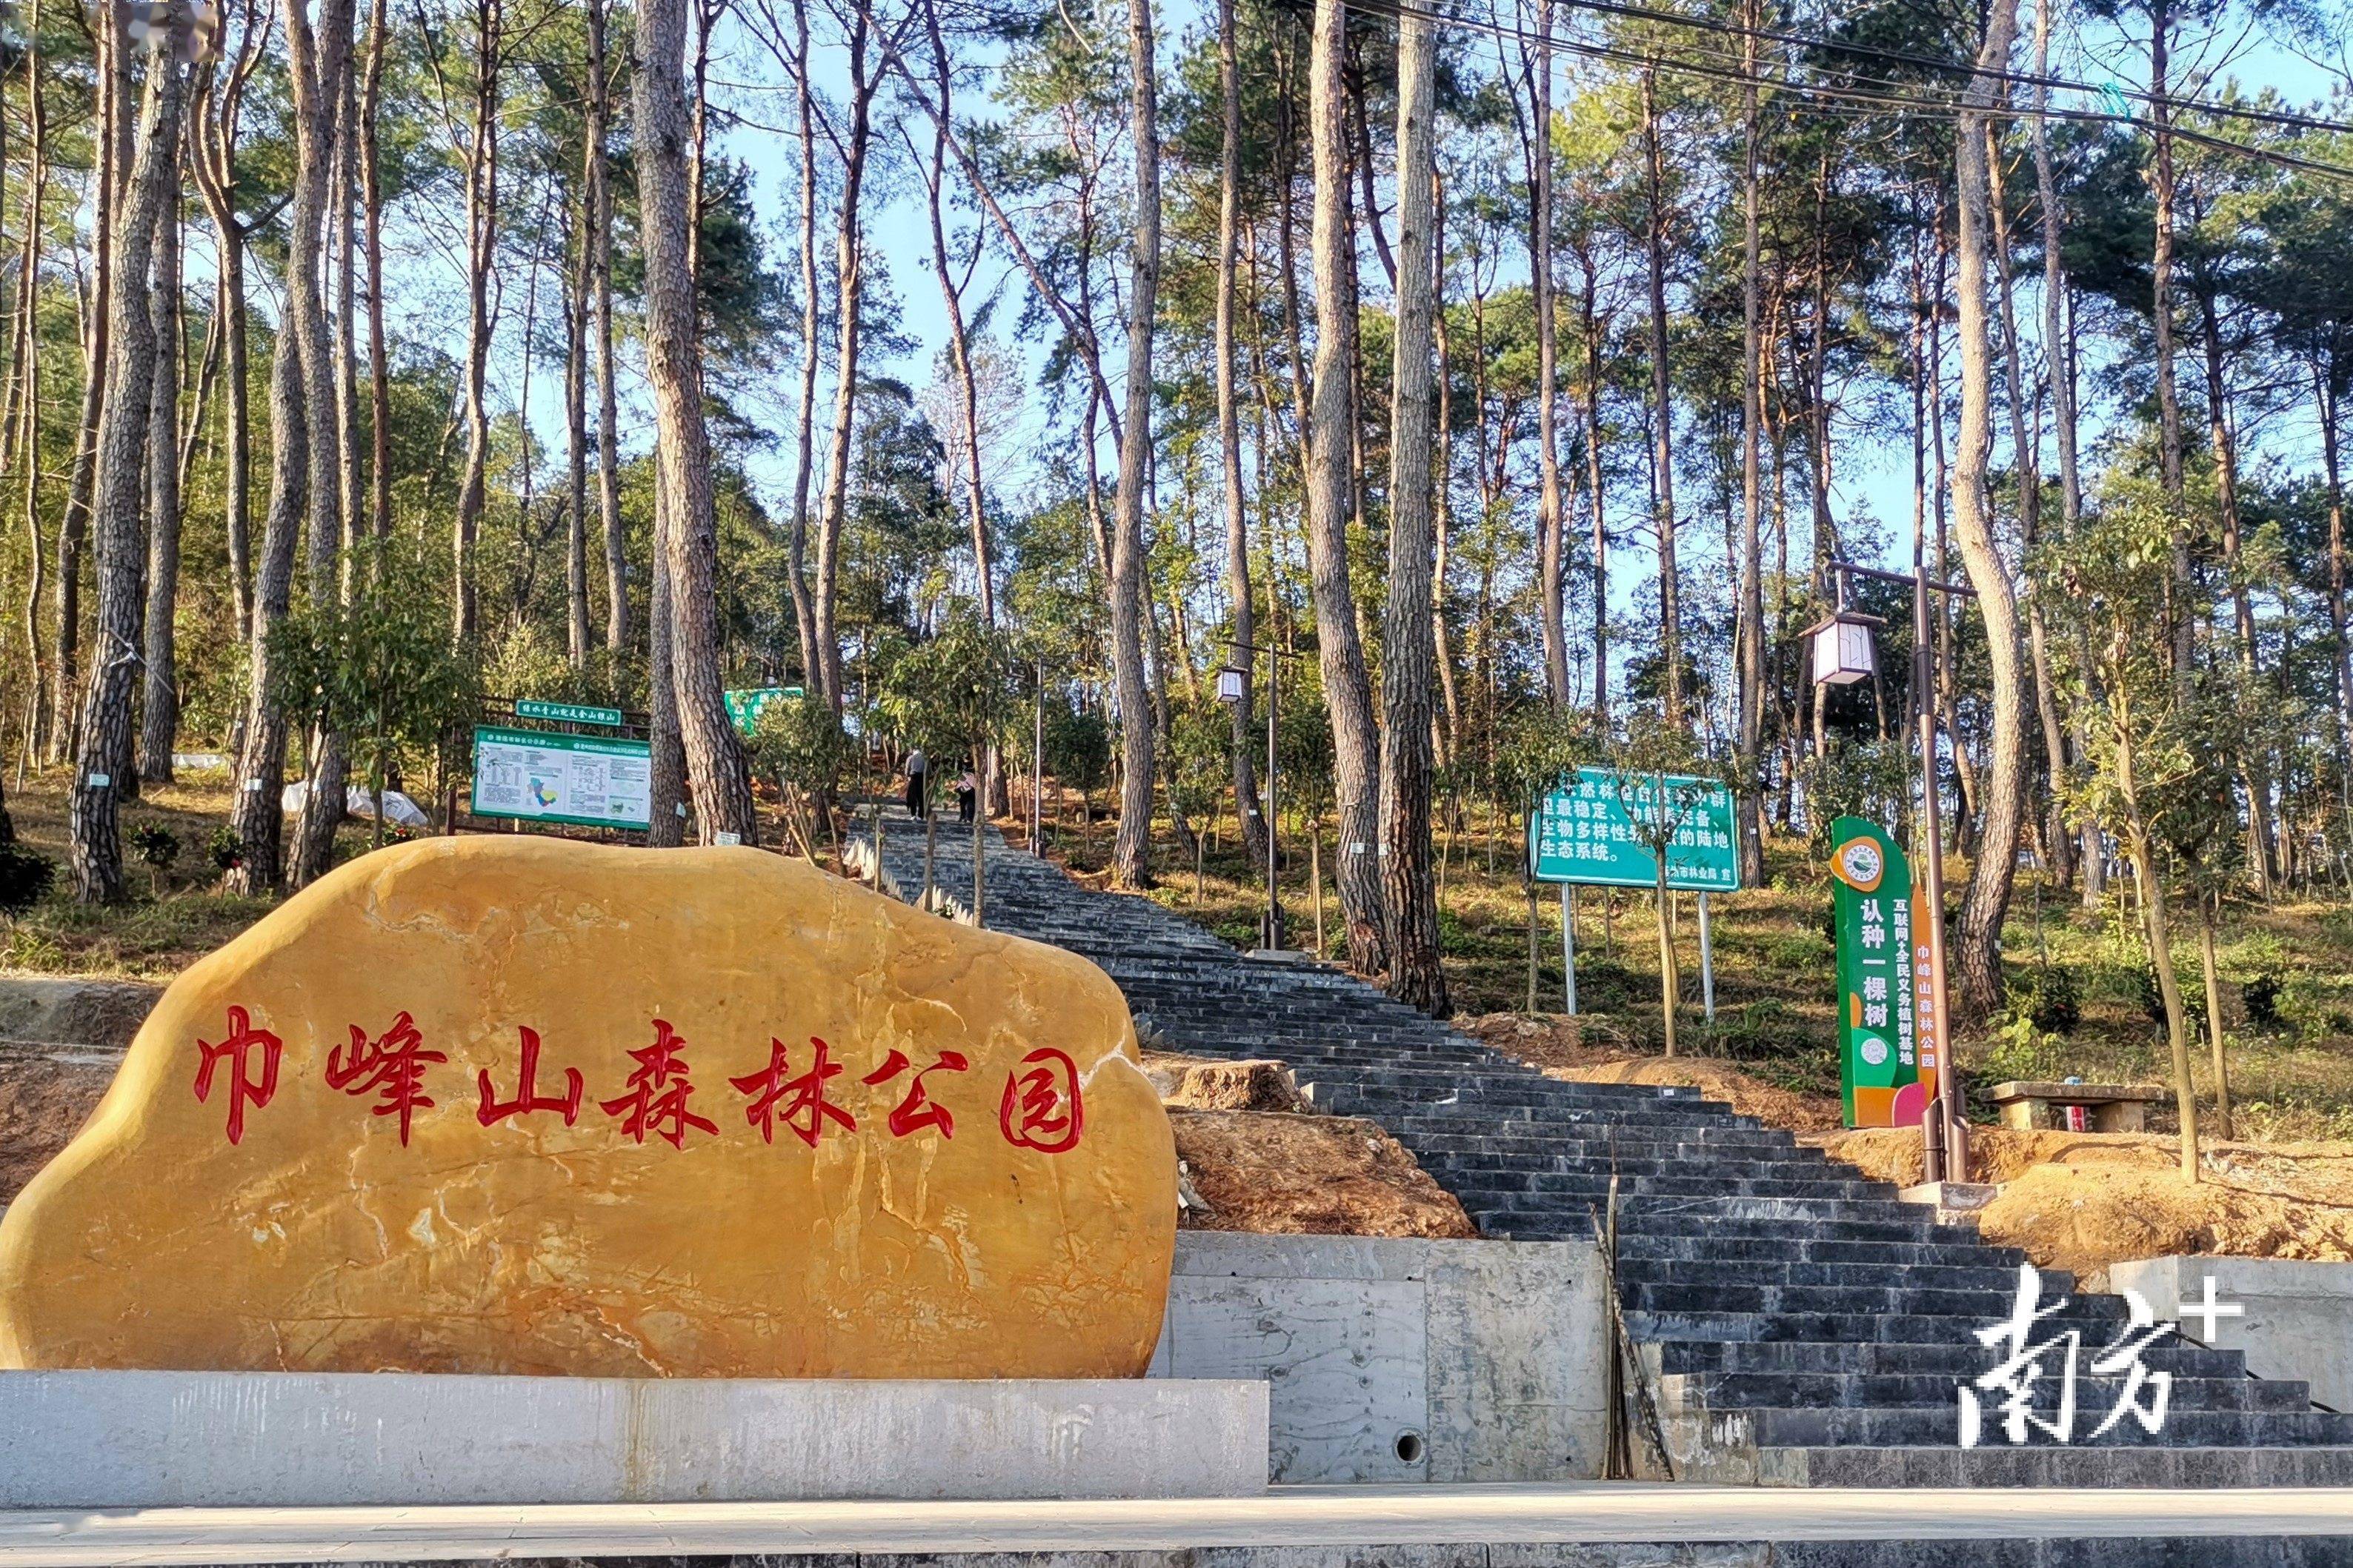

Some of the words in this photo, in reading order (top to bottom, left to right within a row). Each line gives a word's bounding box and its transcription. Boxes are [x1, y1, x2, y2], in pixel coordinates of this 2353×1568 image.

[522, 704, 615, 721] 绿水青山就是金山银山
[1540, 840, 1617, 862] 生态系统。
[1860, 898, 1888, 1027] 认种一棵树
[1892, 898, 1914, 1065] 互联网+全民义务植树基地
[1916, 945, 1935, 1067] 巾峰山森林公园
[194, 1004, 1082, 1152] 巾峰山森林公园
